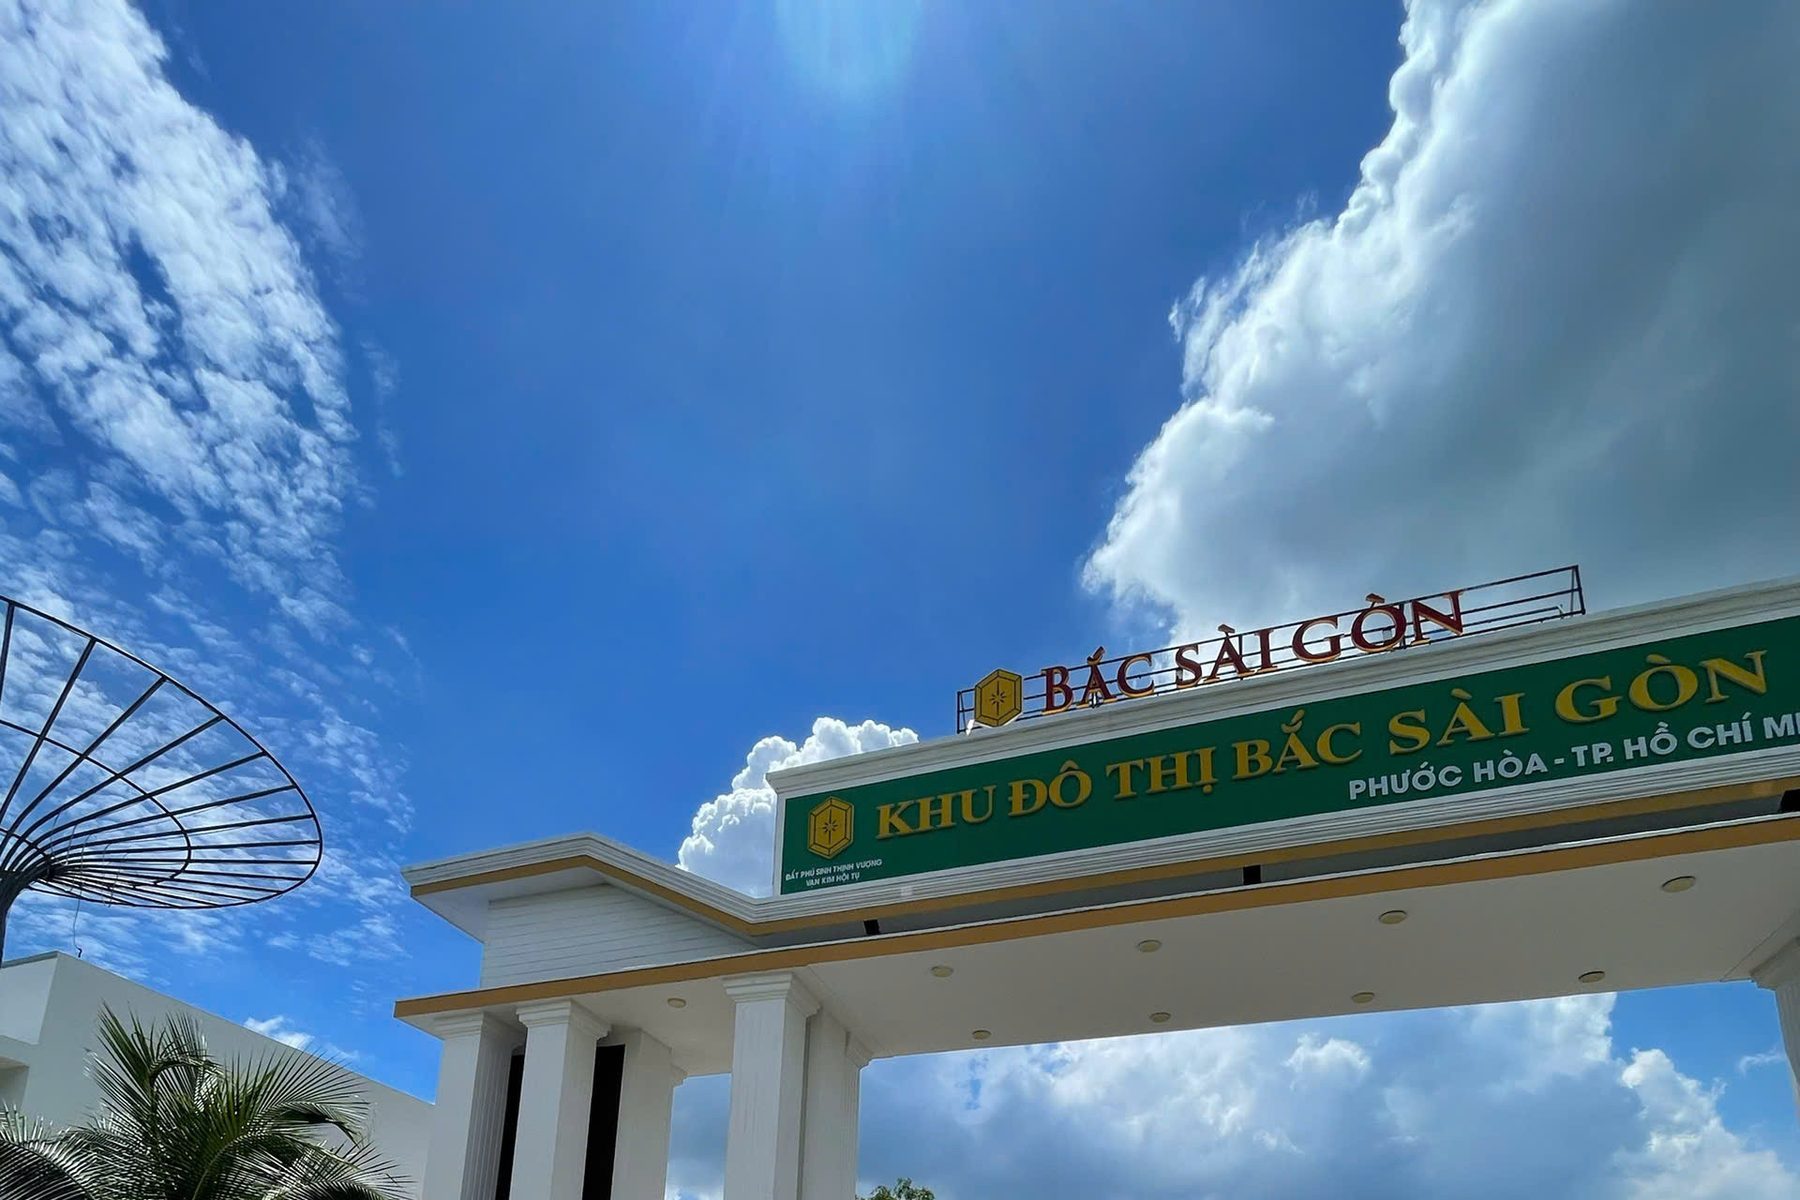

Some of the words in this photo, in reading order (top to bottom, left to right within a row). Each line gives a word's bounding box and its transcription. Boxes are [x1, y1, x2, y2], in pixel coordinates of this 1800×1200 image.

[1040, 646, 1155, 715] BẮC
[1175, 624, 1278, 689] SÀI
[1291, 593, 1465, 664] GÒN
[875, 784, 997, 840] KHU
[1007, 759, 1093, 817] ĐÔ
[1106, 746, 1219, 800] THỊ
[1231, 709, 1363, 780] BẮC
[1388, 688, 1530, 755] SÀI
[1554, 650, 1769, 722] GÒN
[1349, 761, 1463, 800] PHƯỚC
[1473, 749, 1548, 783] HÒA
[1571, 742, 1614, 767] TP.
[1623, 721, 1678, 760] HỒ
[1687, 711, 1753, 749] CHÍ
[816, 866, 832, 876] SINH
[821, 876, 835, 884] KIM
